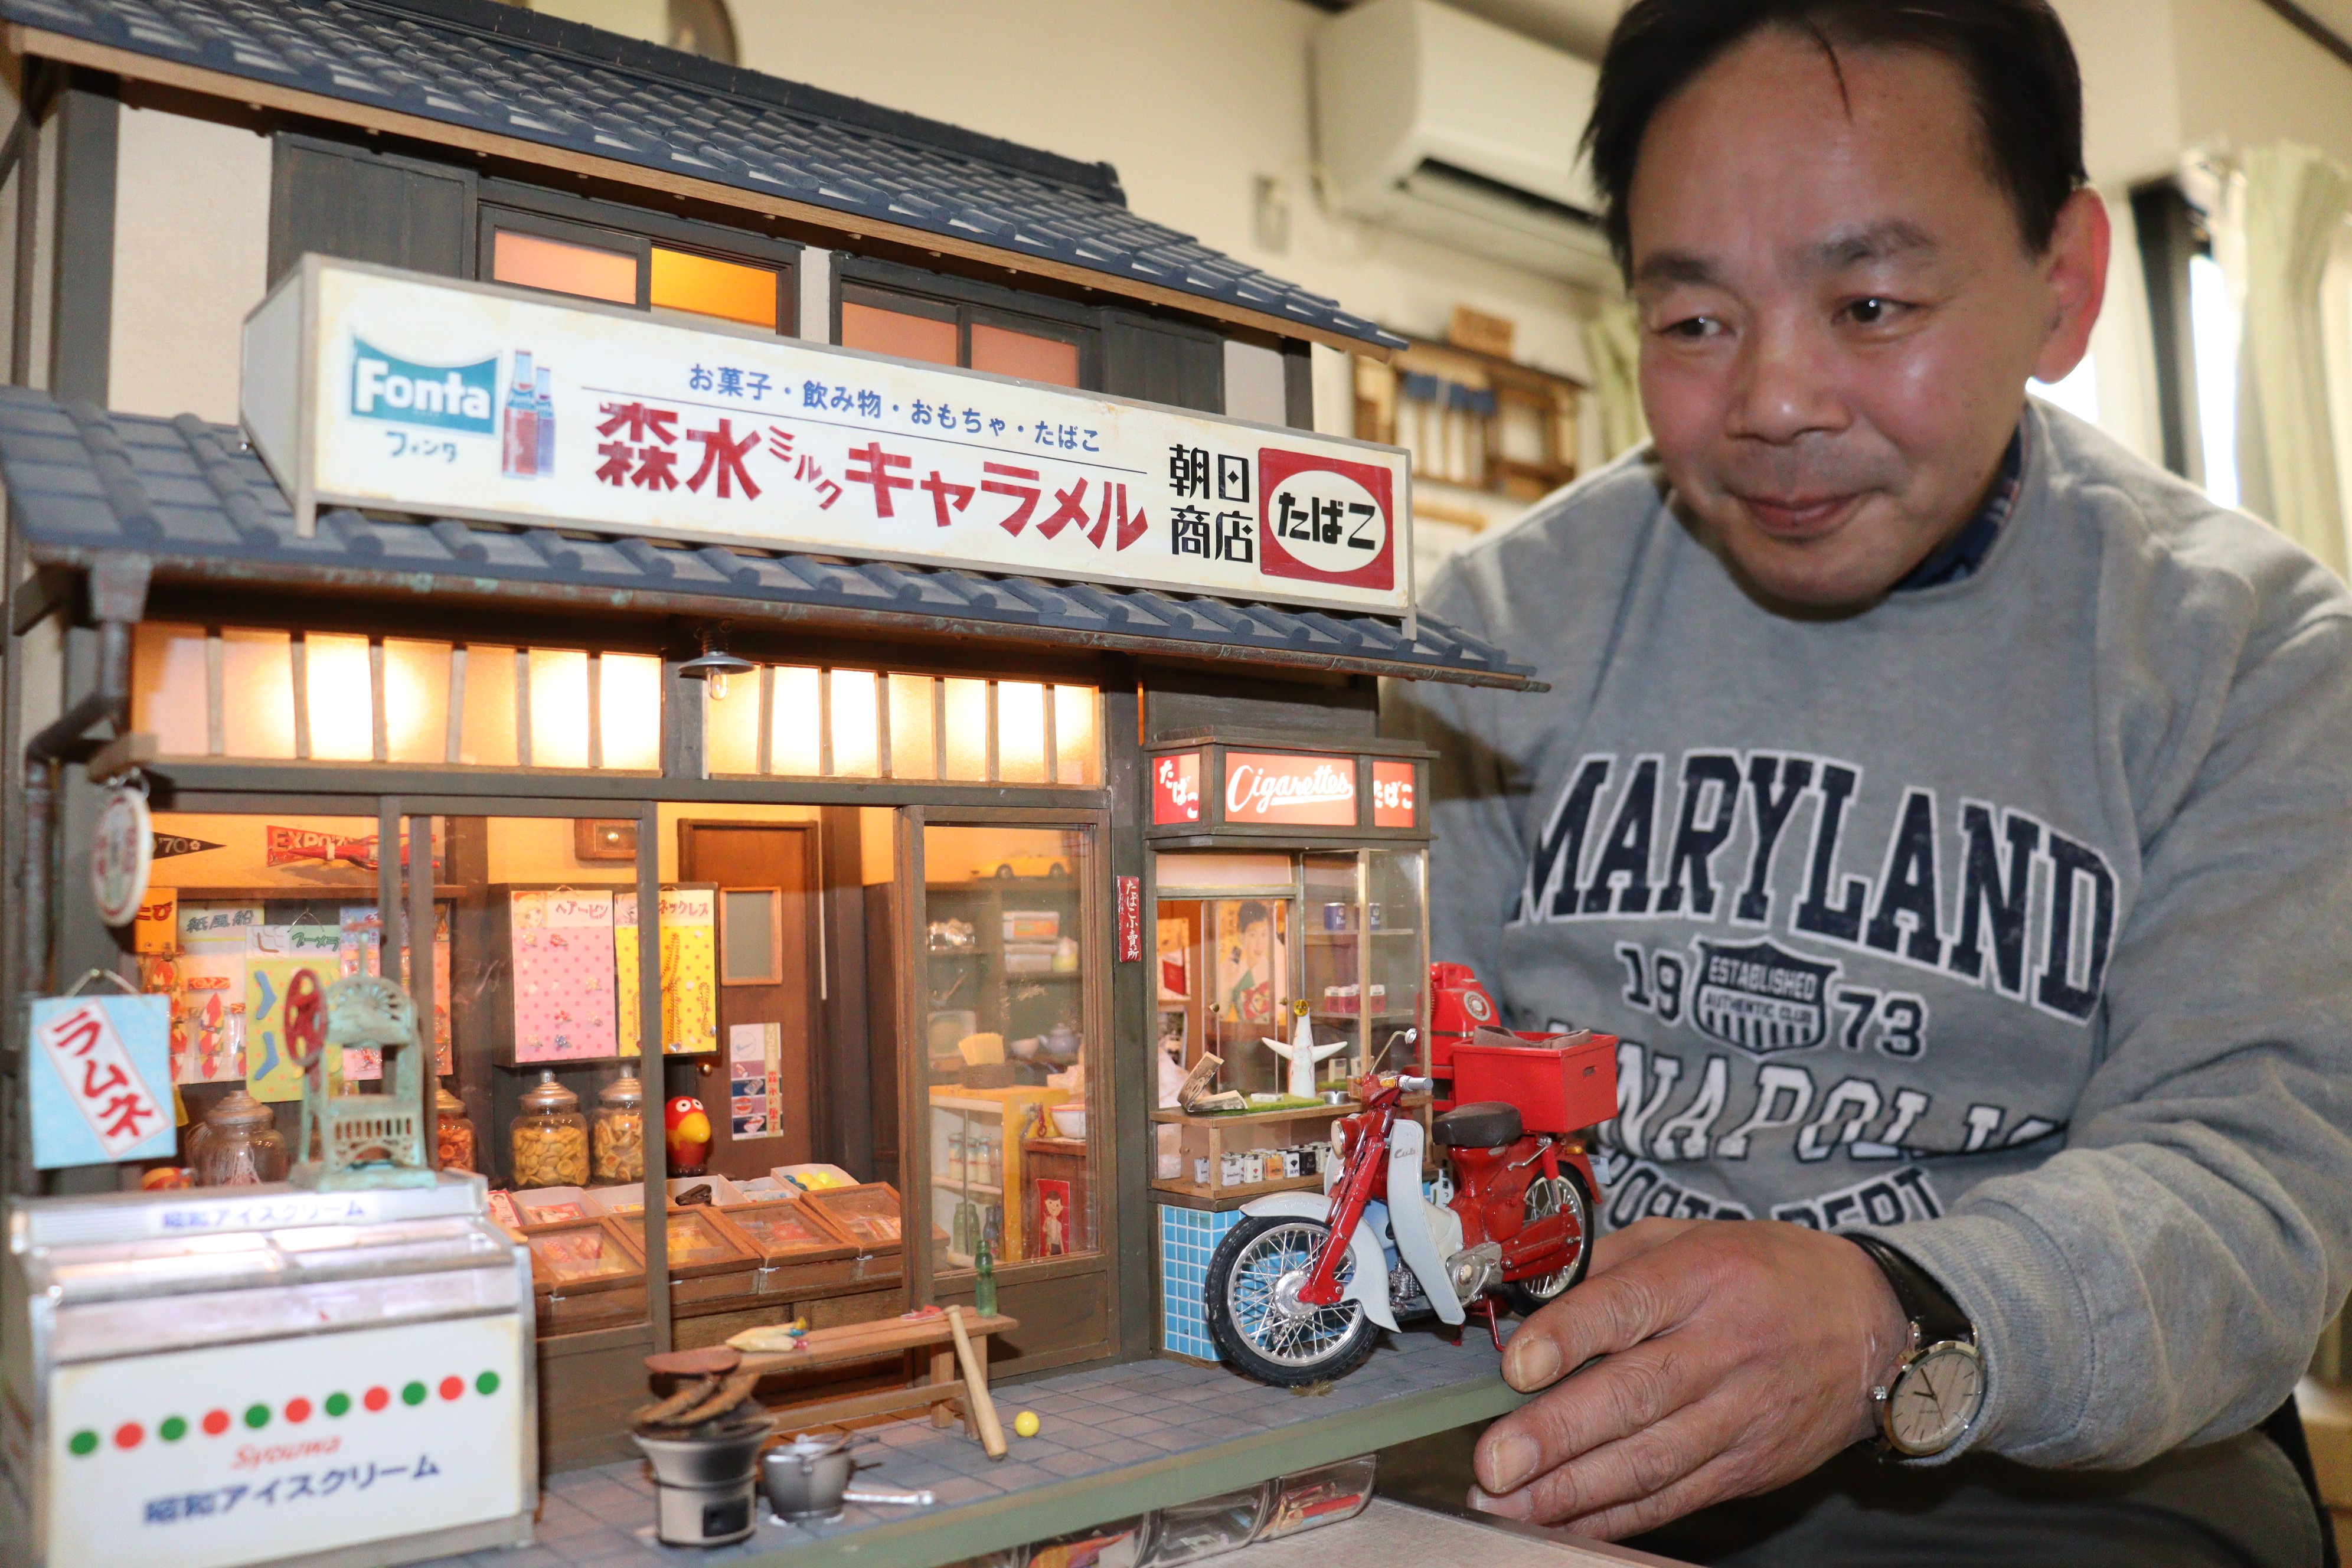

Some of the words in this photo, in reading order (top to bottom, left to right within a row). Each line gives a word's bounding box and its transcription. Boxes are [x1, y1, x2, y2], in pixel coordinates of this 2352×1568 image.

[355, 357, 491, 420] Fonta
[689, 361, 1101, 453] お菓子・飲み物・おもちゃ・たばこ
[387, 431, 456, 463] フンタ
[1169, 443, 1250, 503] 朝日
[1170, 505, 1254, 564] 商店
[1277, 492, 1376, 550] たばこ
[1159, 759, 1199, 819] たばこ
[1227, 764, 1353, 814] Cigarettes
[1373, 779, 1413, 809] たばこ
[272, 828, 354, 852] EXPO'7
[659, 899, 709, 917] ネックレス
[1502, 748, 2124, 1028] MARYLAND
[186, 910, 254, 933] 紙風船
[292, 932, 340, 952] ブーメラ
[1615, 942, 1688, 1028] 19
[1833, 984, 1929, 1061] 73
[1708, 955, 1818, 1001] ESTABLISHED
[53, 1011, 153, 1137] ラムネ
[1544, 1017, 2069, 1165] NAPOLI
[1394, 1148, 1416, 1159] Cub
[144, 1453, 440, 1524] 昭和アイスクリーム
